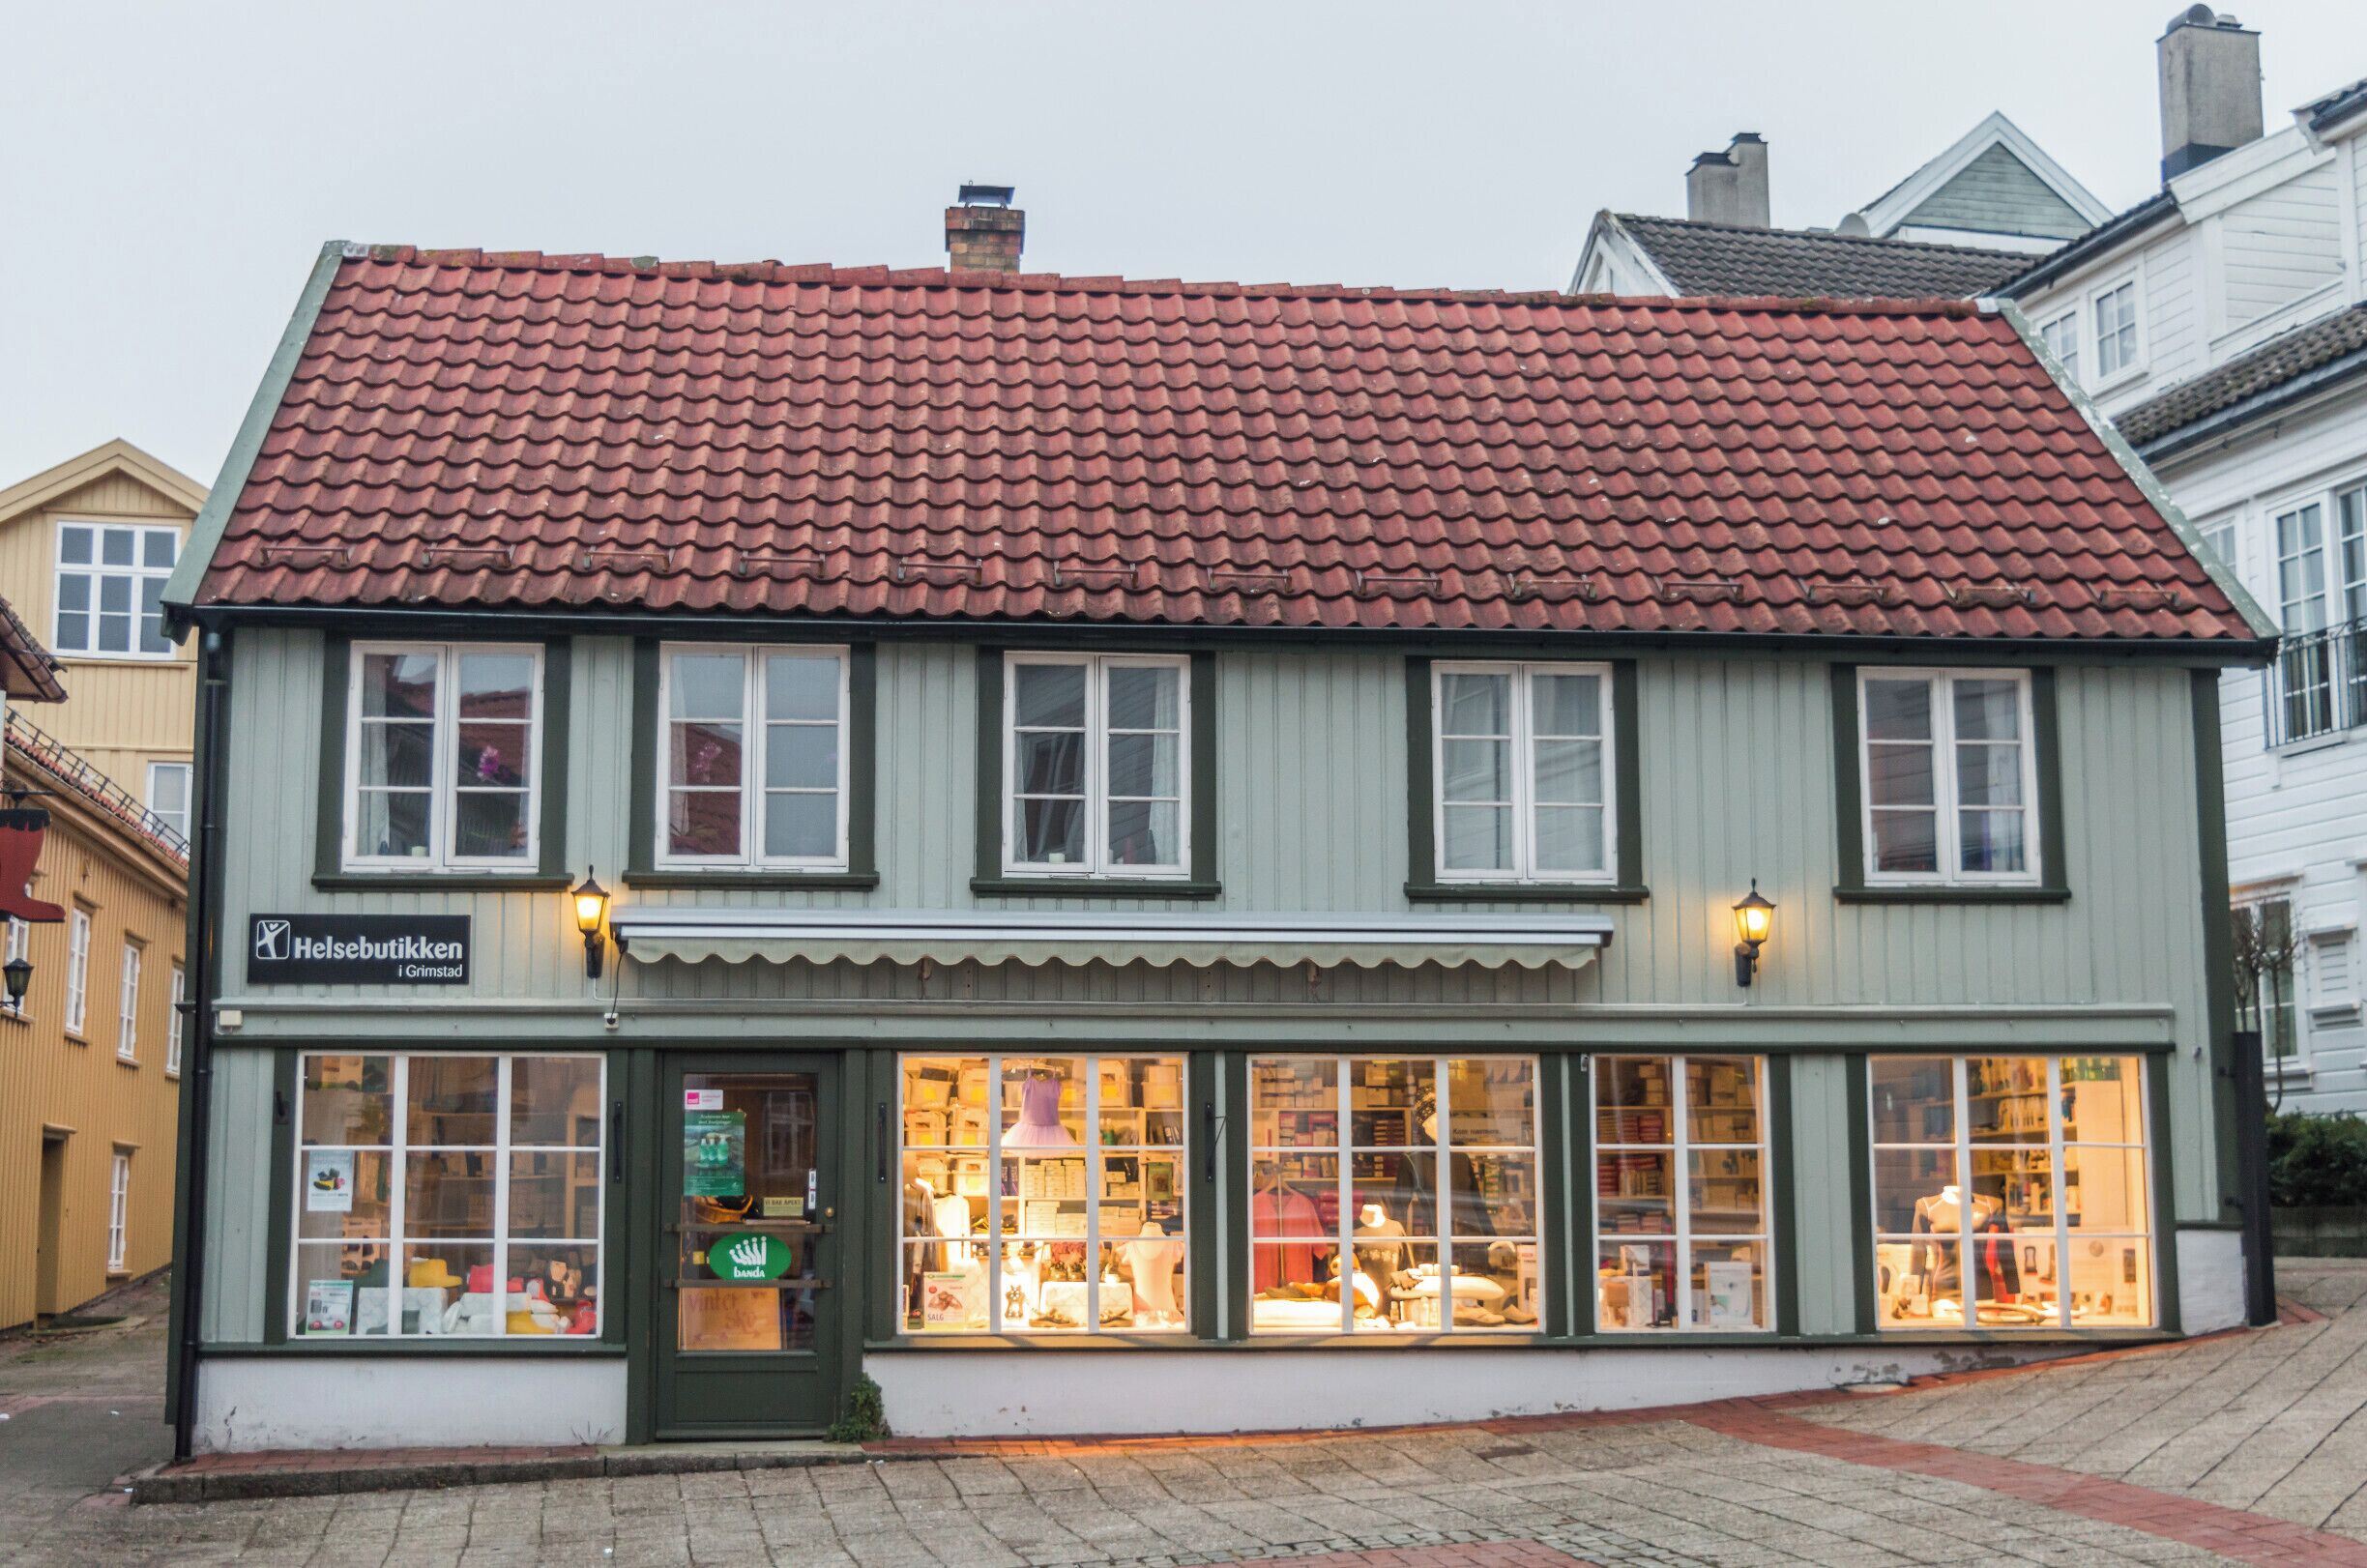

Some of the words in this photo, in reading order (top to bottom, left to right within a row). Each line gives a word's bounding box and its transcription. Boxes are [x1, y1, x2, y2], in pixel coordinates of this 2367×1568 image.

[294, 935, 463, 959] Helsebutikken
[398, 965, 402, 977] i
[406, 964, 463, 977] Grimstad
